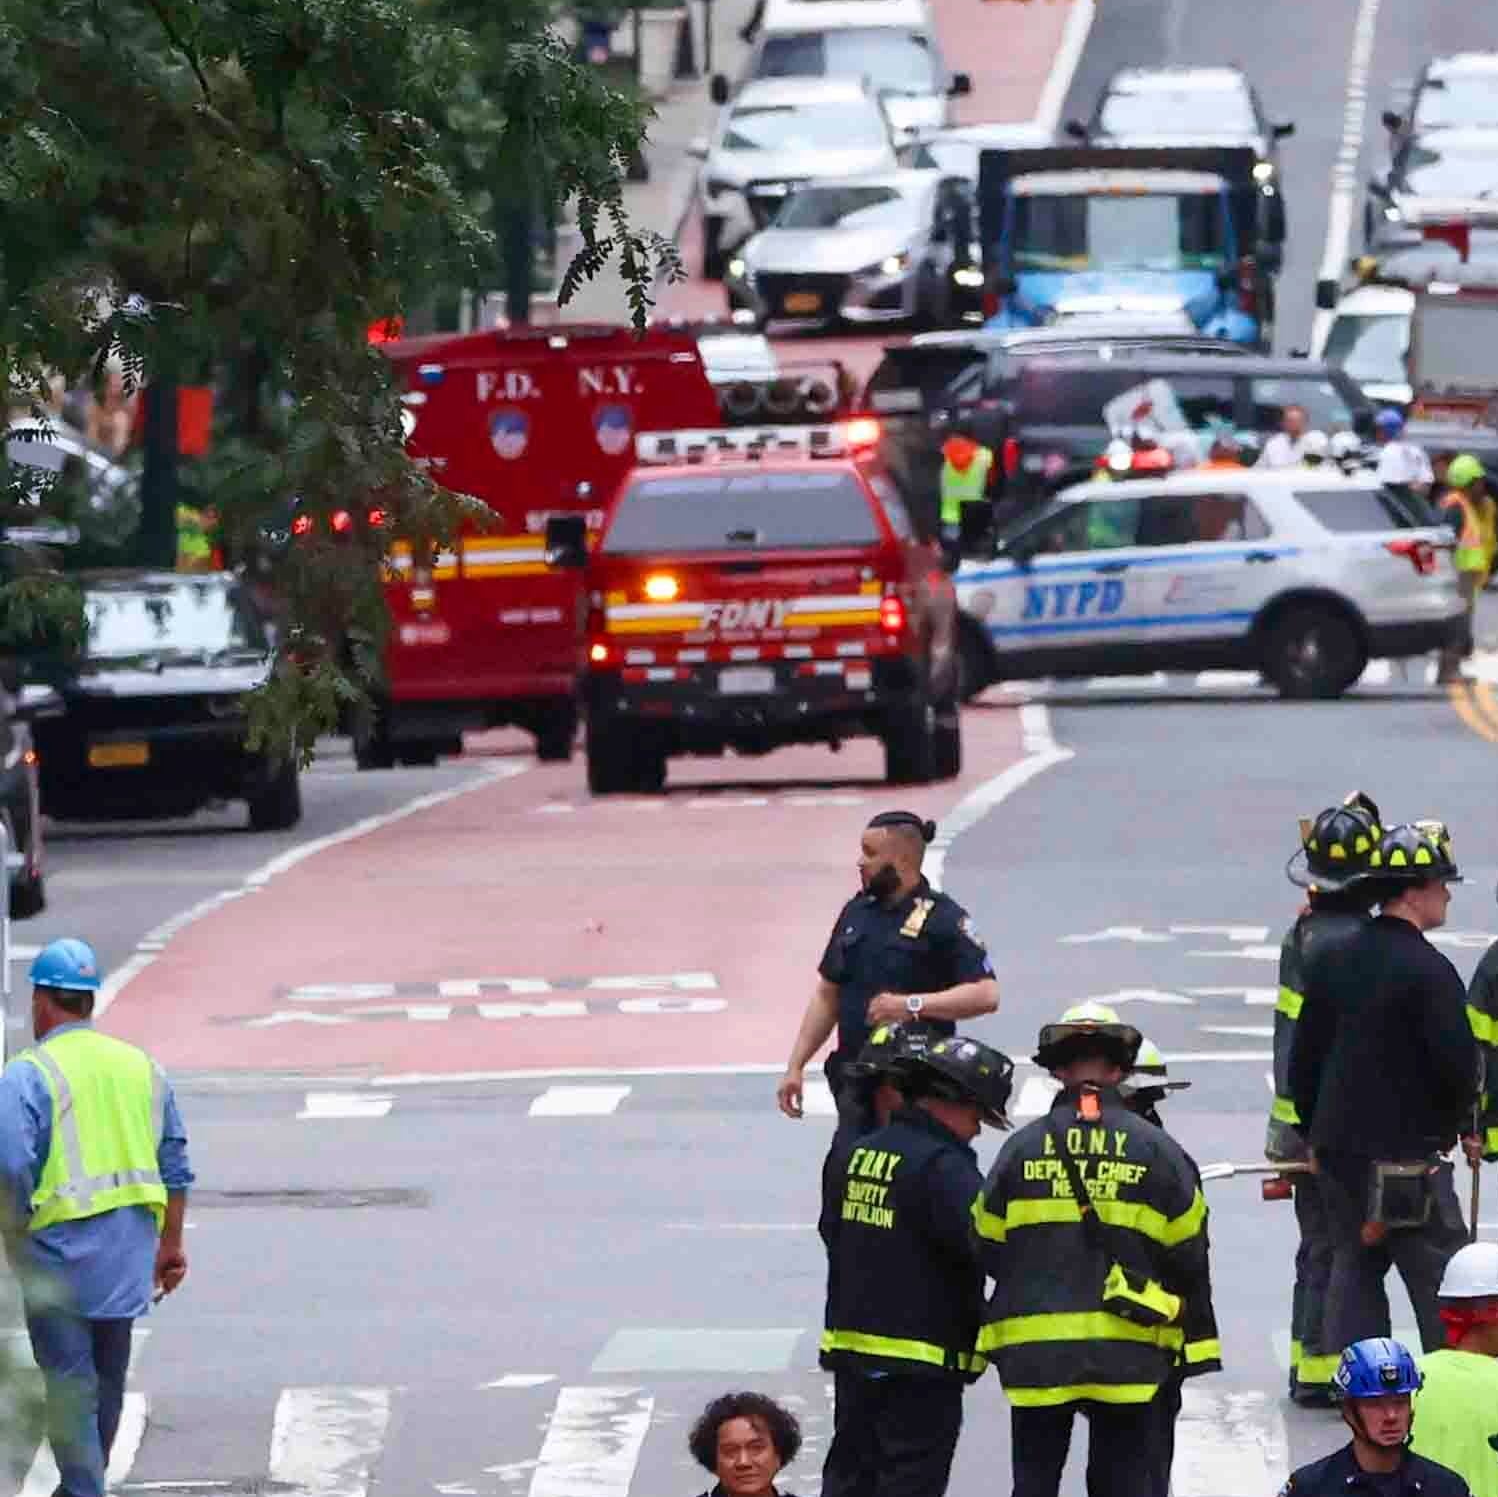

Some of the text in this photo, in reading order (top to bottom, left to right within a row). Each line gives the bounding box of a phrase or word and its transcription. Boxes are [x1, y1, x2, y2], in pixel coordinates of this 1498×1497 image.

[703, 600, 786, 630] FDNY
[1024, 579, 1124, 622] NYPD
[1024, 1159, 1147, 1184] DEPUY CHIEF
